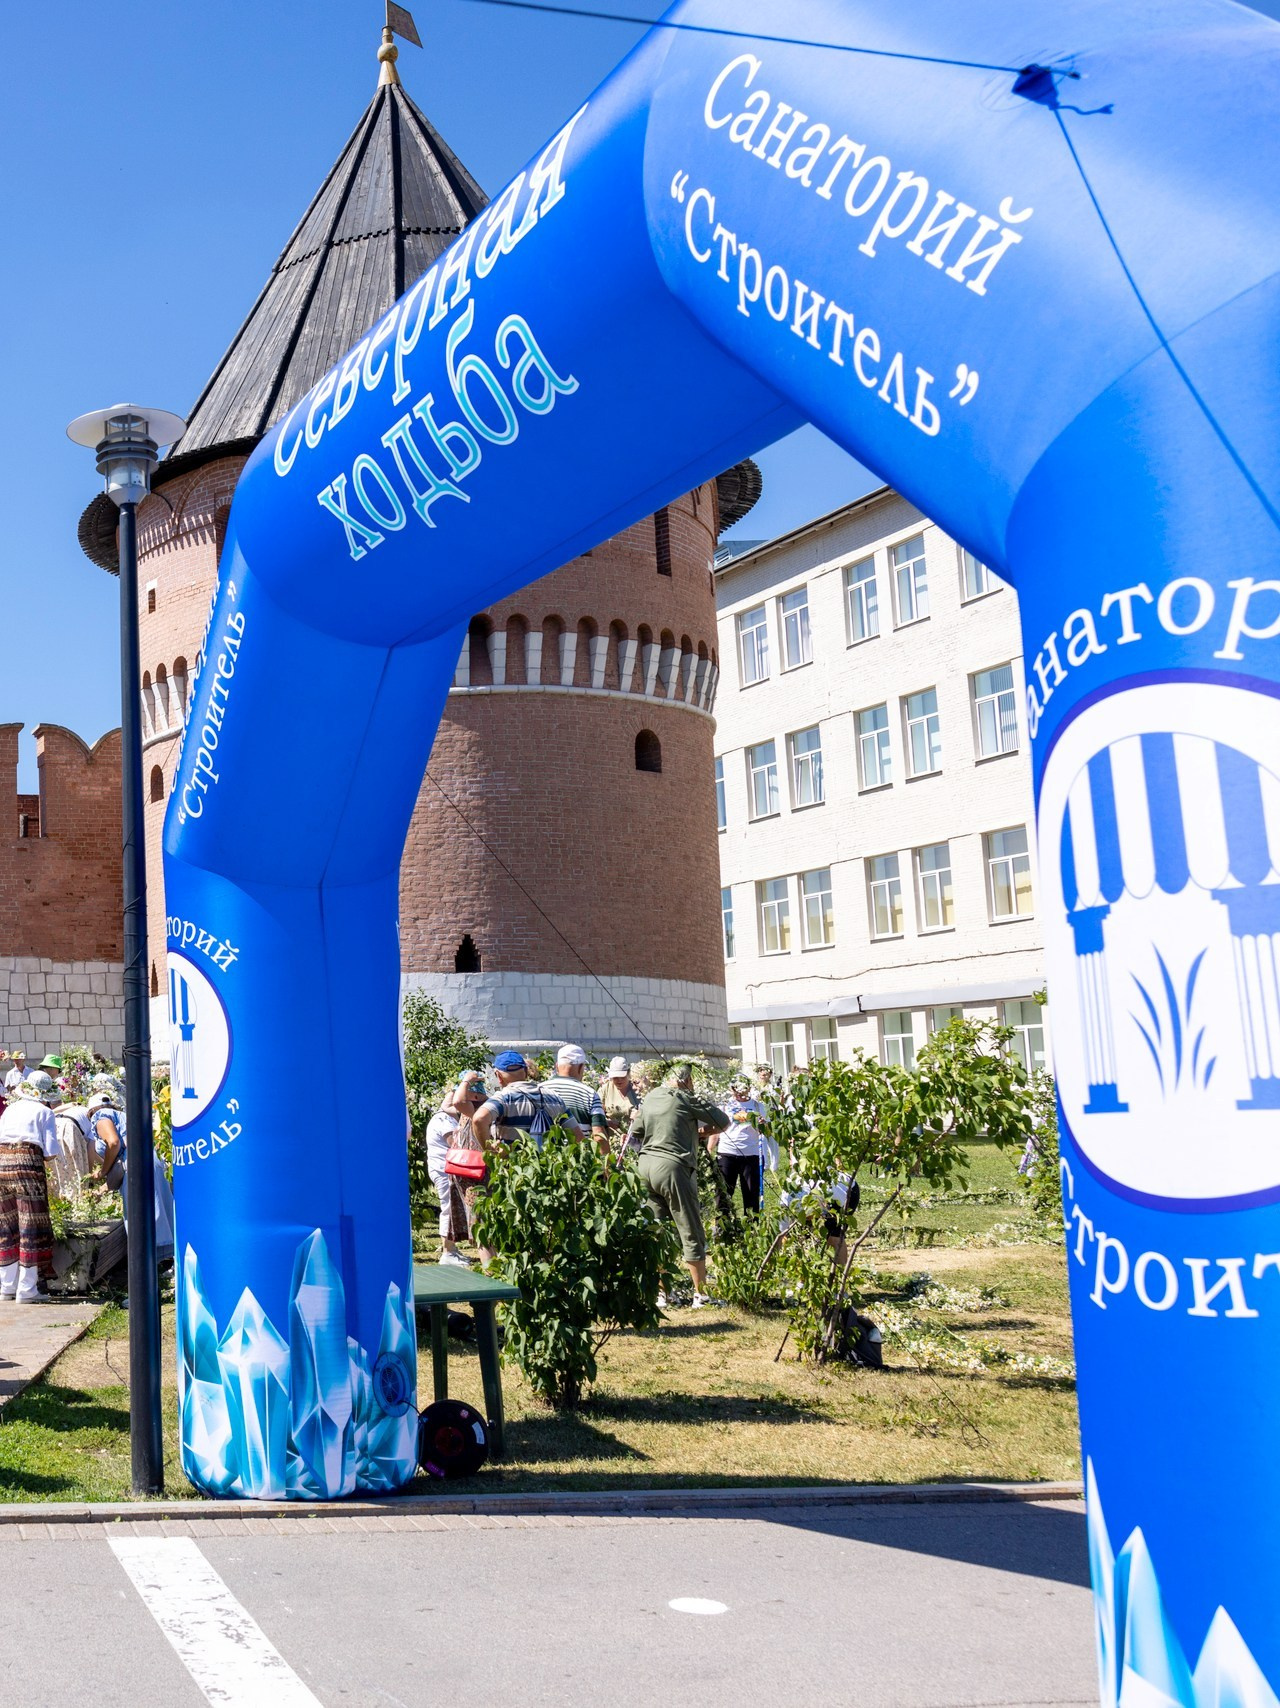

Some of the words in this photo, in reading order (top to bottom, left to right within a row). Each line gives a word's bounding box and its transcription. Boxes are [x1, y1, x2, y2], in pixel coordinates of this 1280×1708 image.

[273, 102, 589, 477] Северная
[703, 53, 1034, 297] Санаторий
[317, 298, 580, 561] ходьба
[671, 169, 979, 437] “Строитель”
[1026, 576, 1280, 739] анатор
[167, 916, 240, 973] торий
